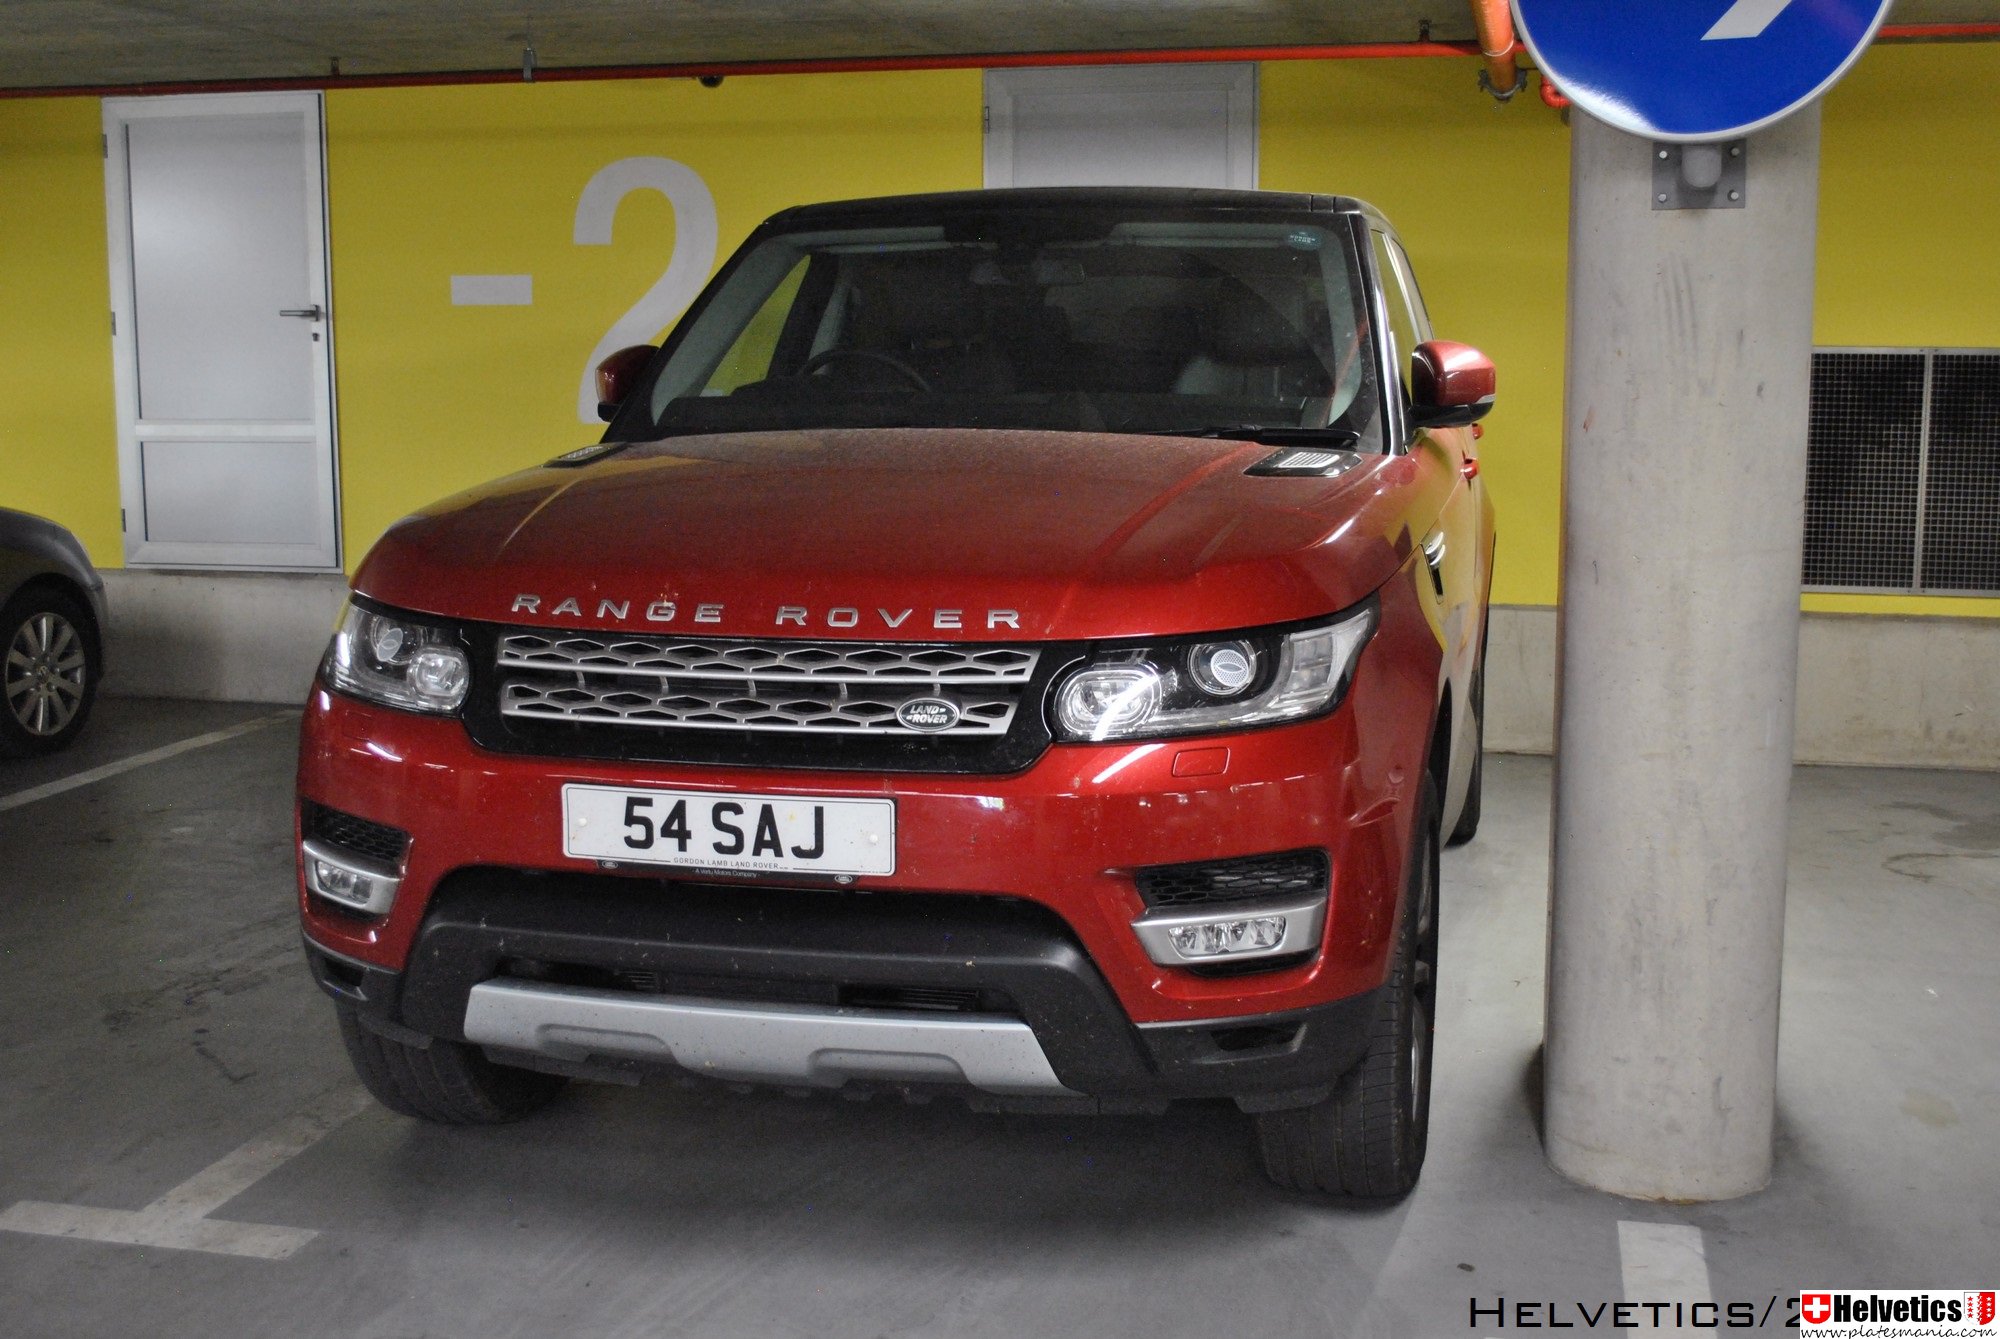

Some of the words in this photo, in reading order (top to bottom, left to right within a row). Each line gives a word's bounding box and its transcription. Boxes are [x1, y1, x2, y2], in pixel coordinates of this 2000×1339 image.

[512, 593, 724, 623] RANGE
[775, 606, 1020, 629] ROVER
[623, 796, 692, 853] 54
[711, 801, 824, 860] SAJ
[673, 857, 705, 865] GORDON
[730, 860, 750, 868] LAND
[752, 862, 779, 870] ROVER
